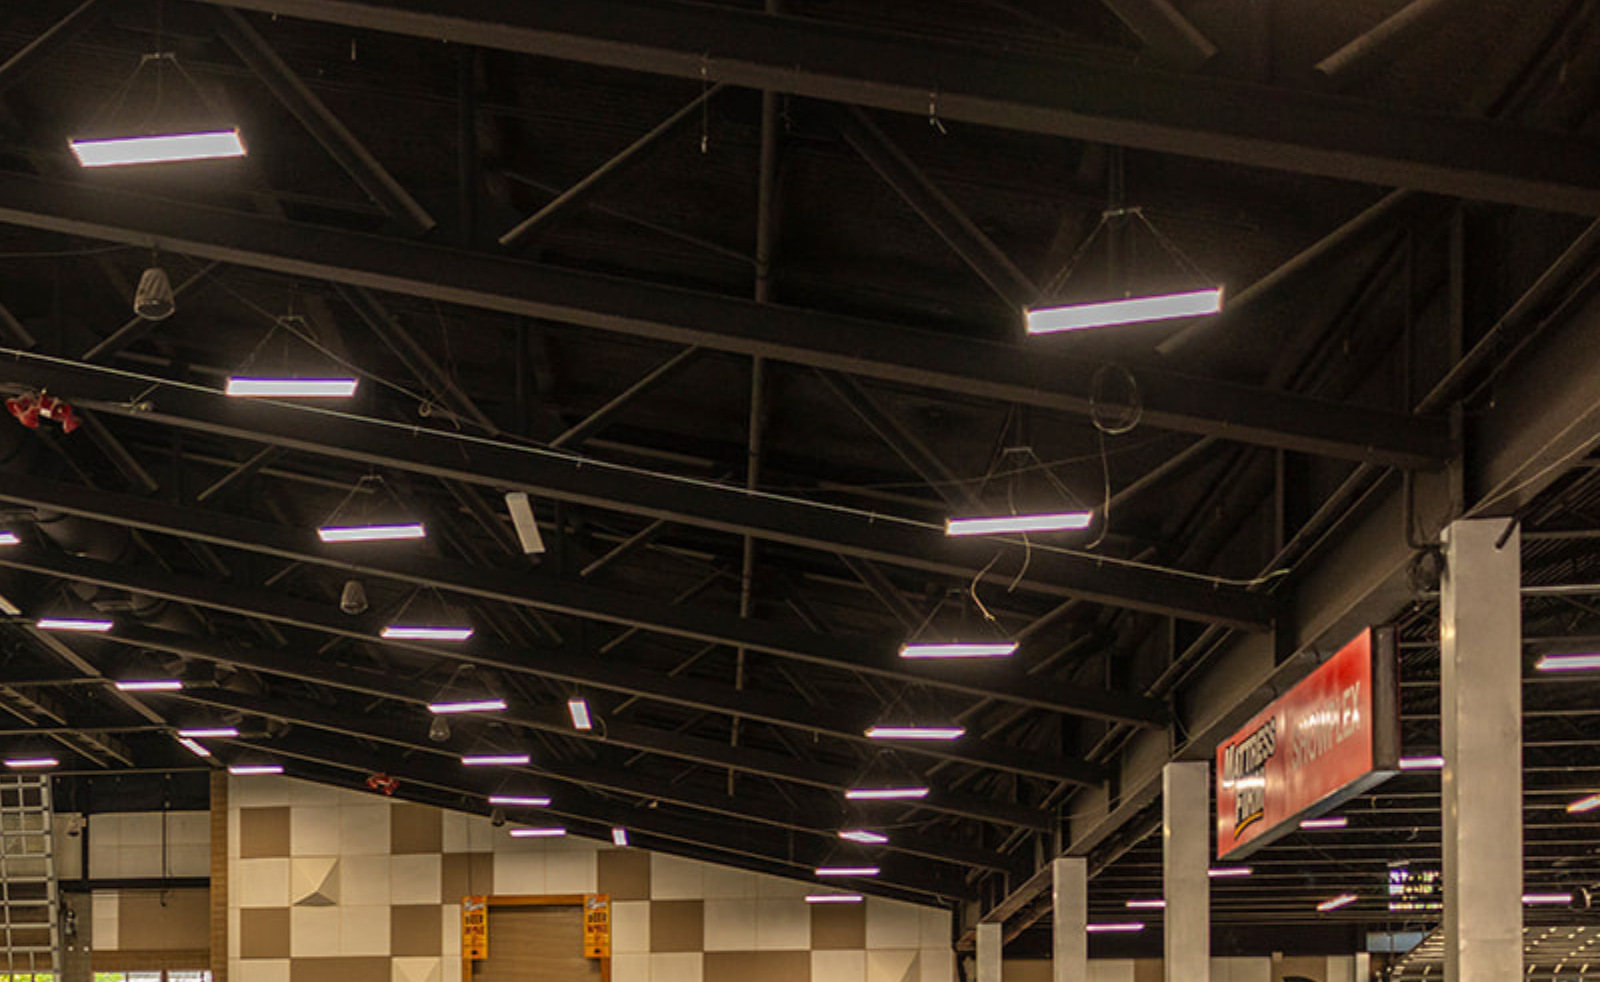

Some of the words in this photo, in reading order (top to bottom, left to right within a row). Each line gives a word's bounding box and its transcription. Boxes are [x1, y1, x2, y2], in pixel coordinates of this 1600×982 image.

[1223, 716, 1276, 789] MATTRESS
[1292, 681, 1360, 770] SHOWPLEX
[1236, 769, 1265, 824] FIRM
